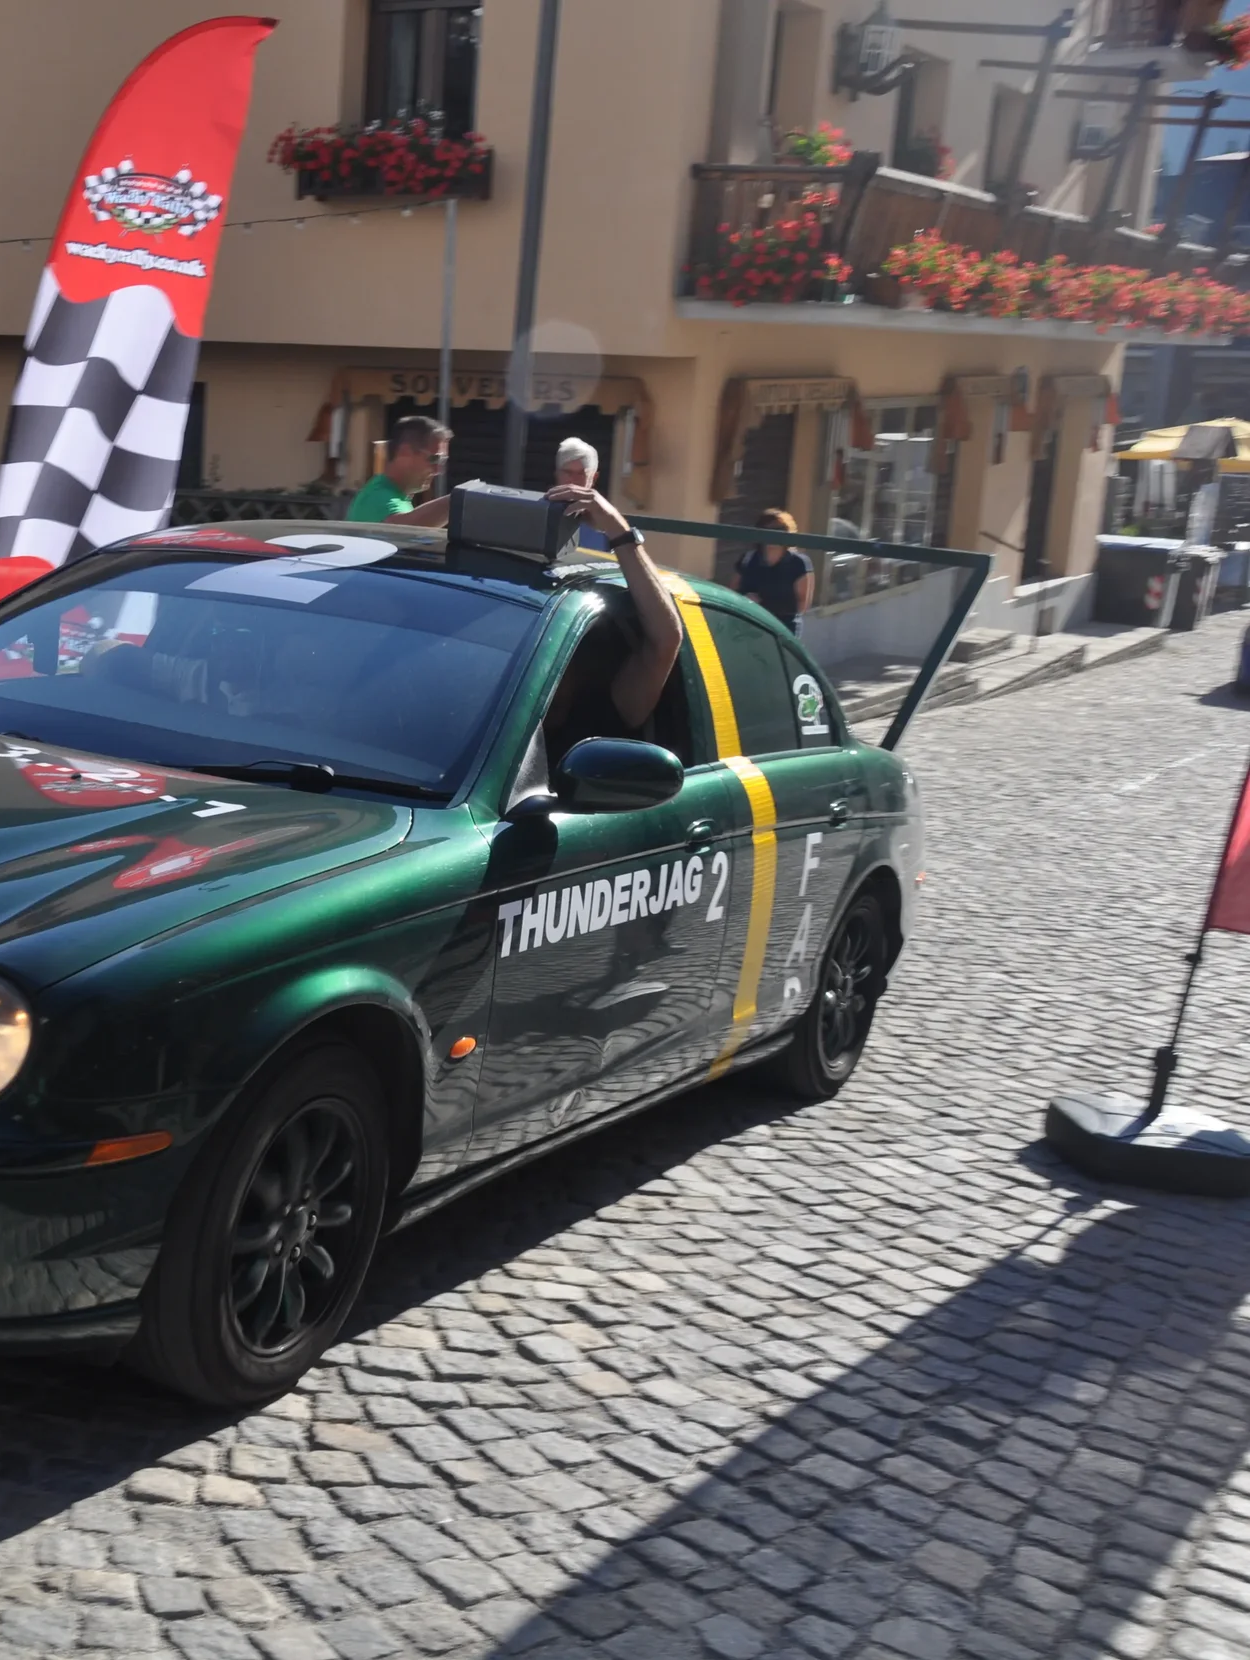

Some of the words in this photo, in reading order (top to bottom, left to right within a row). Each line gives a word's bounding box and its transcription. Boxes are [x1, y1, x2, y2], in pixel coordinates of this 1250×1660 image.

[389, 373, 576, 401] SOVERS
[184, 534, 398, 604] 2
[497, 855, 703, 959] THUNDERJAG
[705, 851, 729, 923] 2
